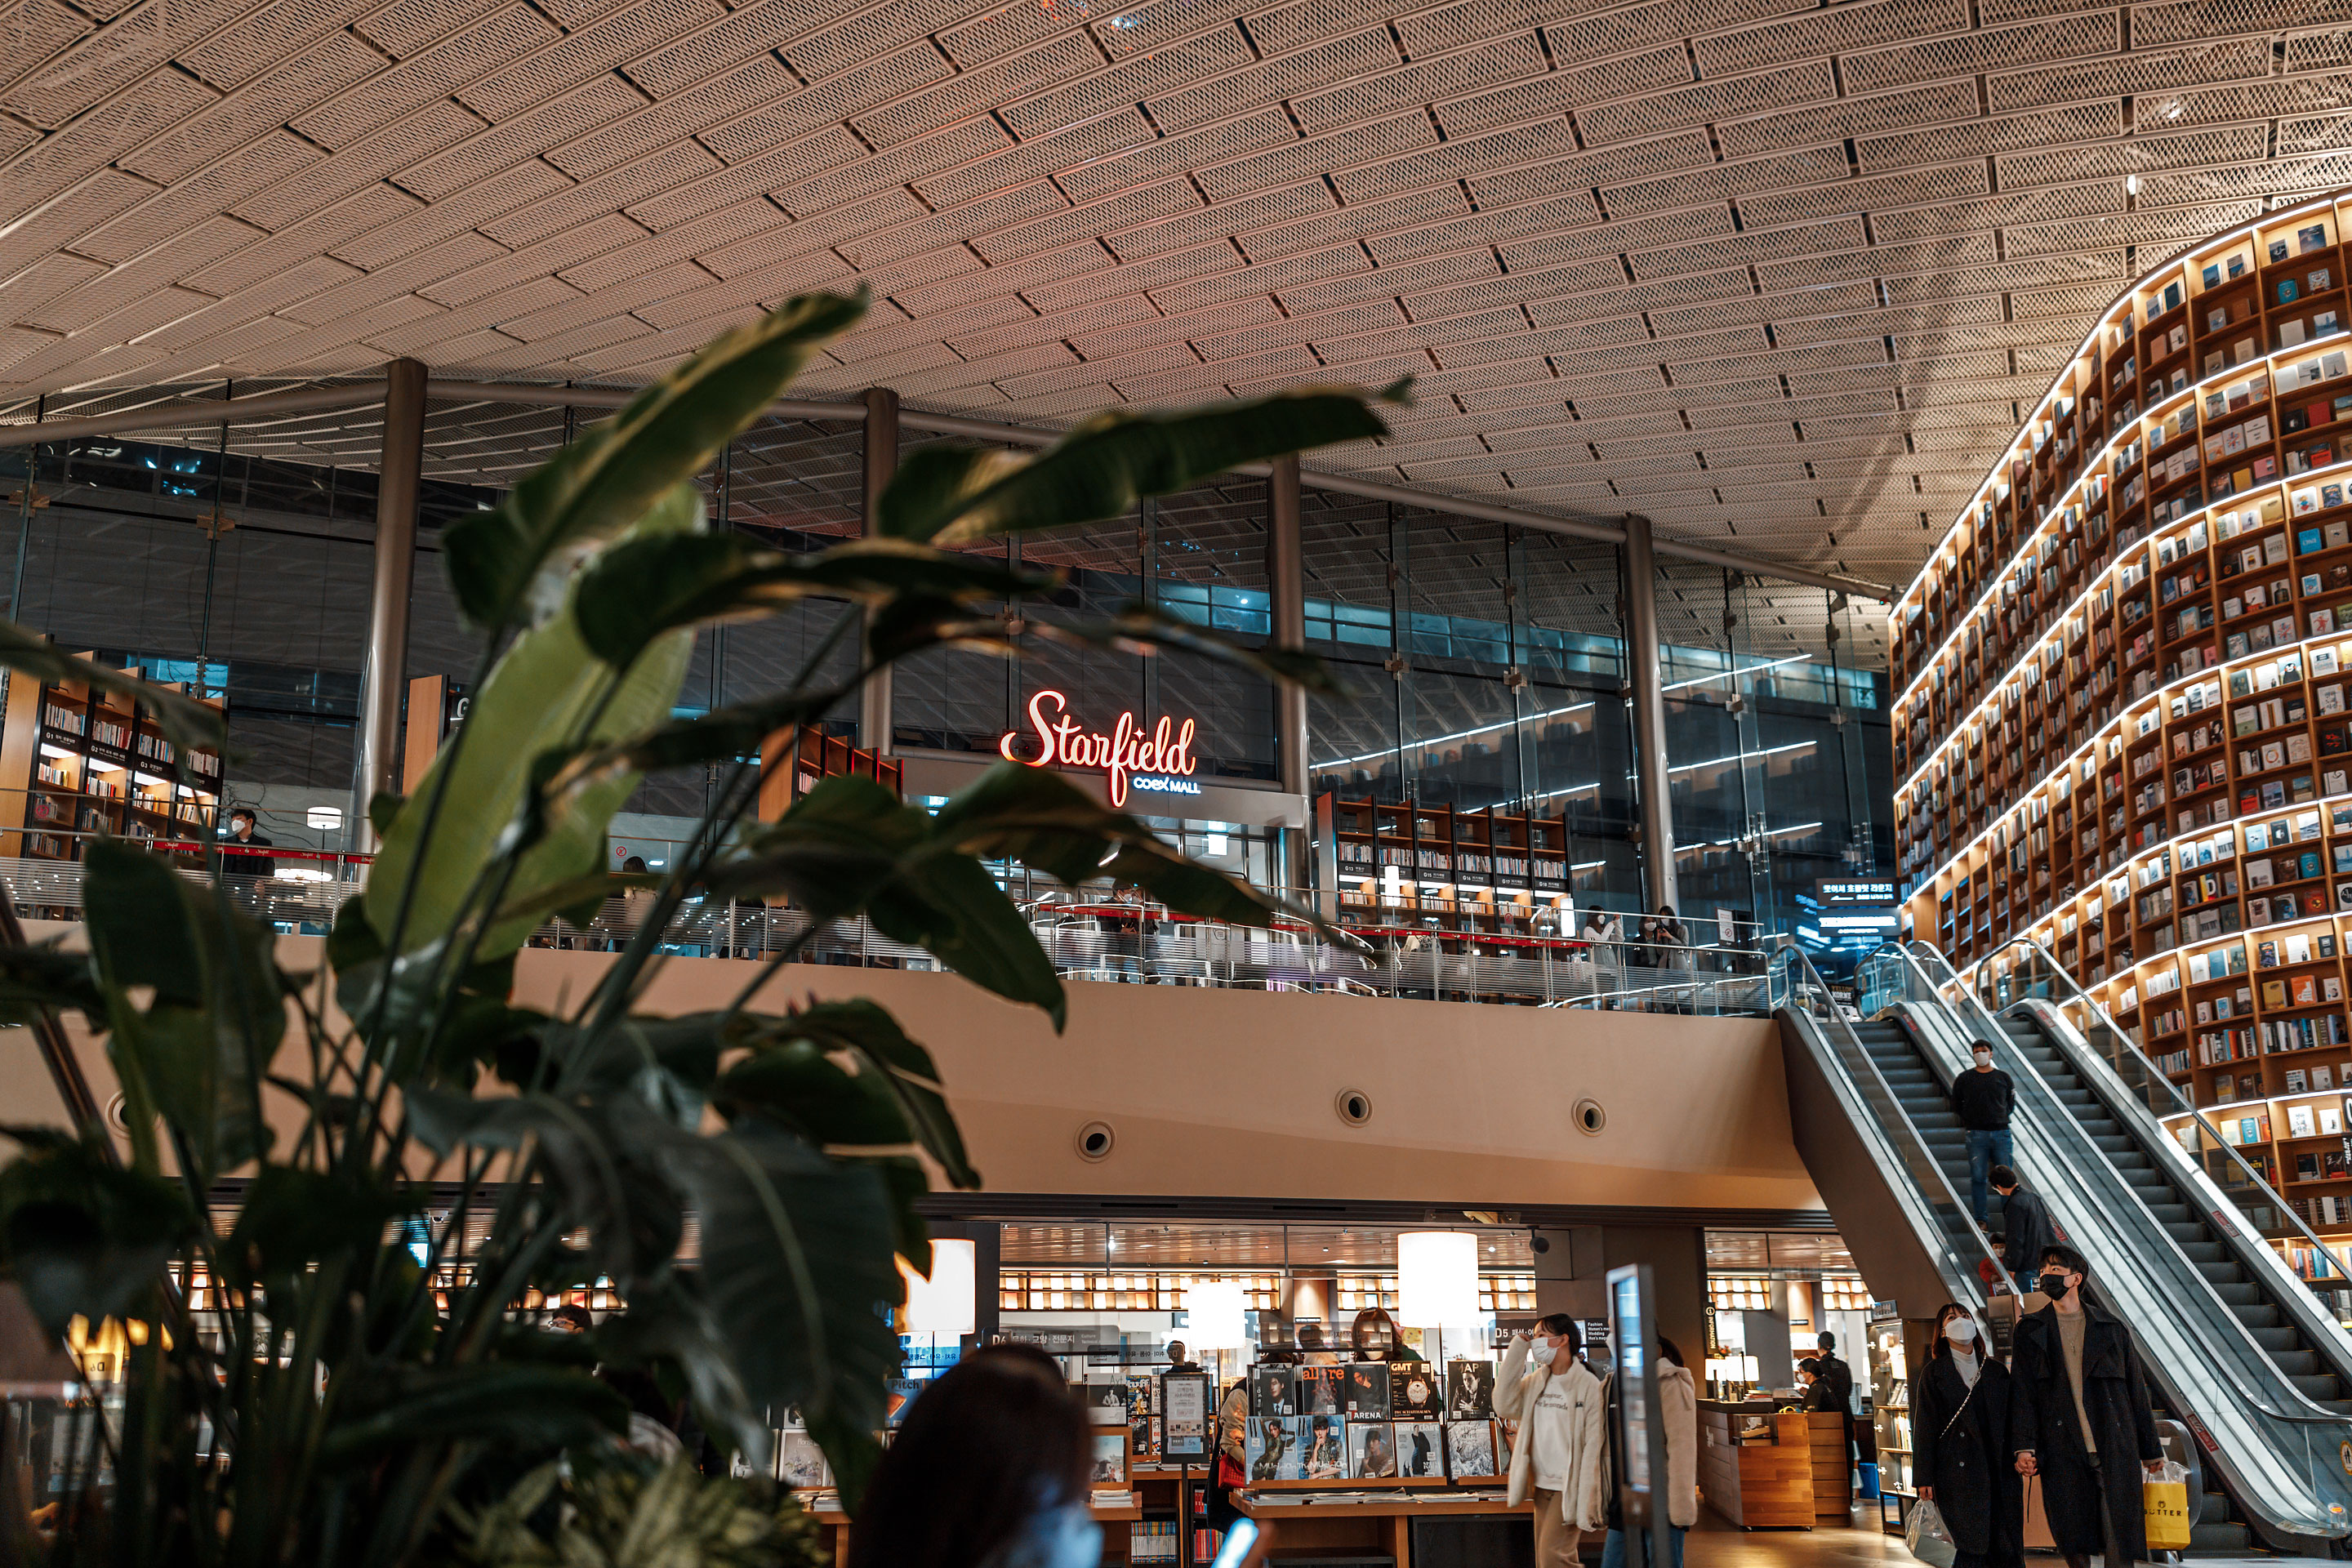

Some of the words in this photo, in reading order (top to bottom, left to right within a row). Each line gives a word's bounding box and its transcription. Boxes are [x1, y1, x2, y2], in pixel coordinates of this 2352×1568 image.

[1000, 690, 1196, 807] Starfield
[1170, 782, 1200, 794] MALL
[1495, 1327, 1508, 1338] D5
[992, 1334, 1006, 1345] D6
[1391, 1362, 1413, 1371] GMT
[1303, 1367, 1345, 1380] allre
[892, 1379, 920, 1389] Pitch
